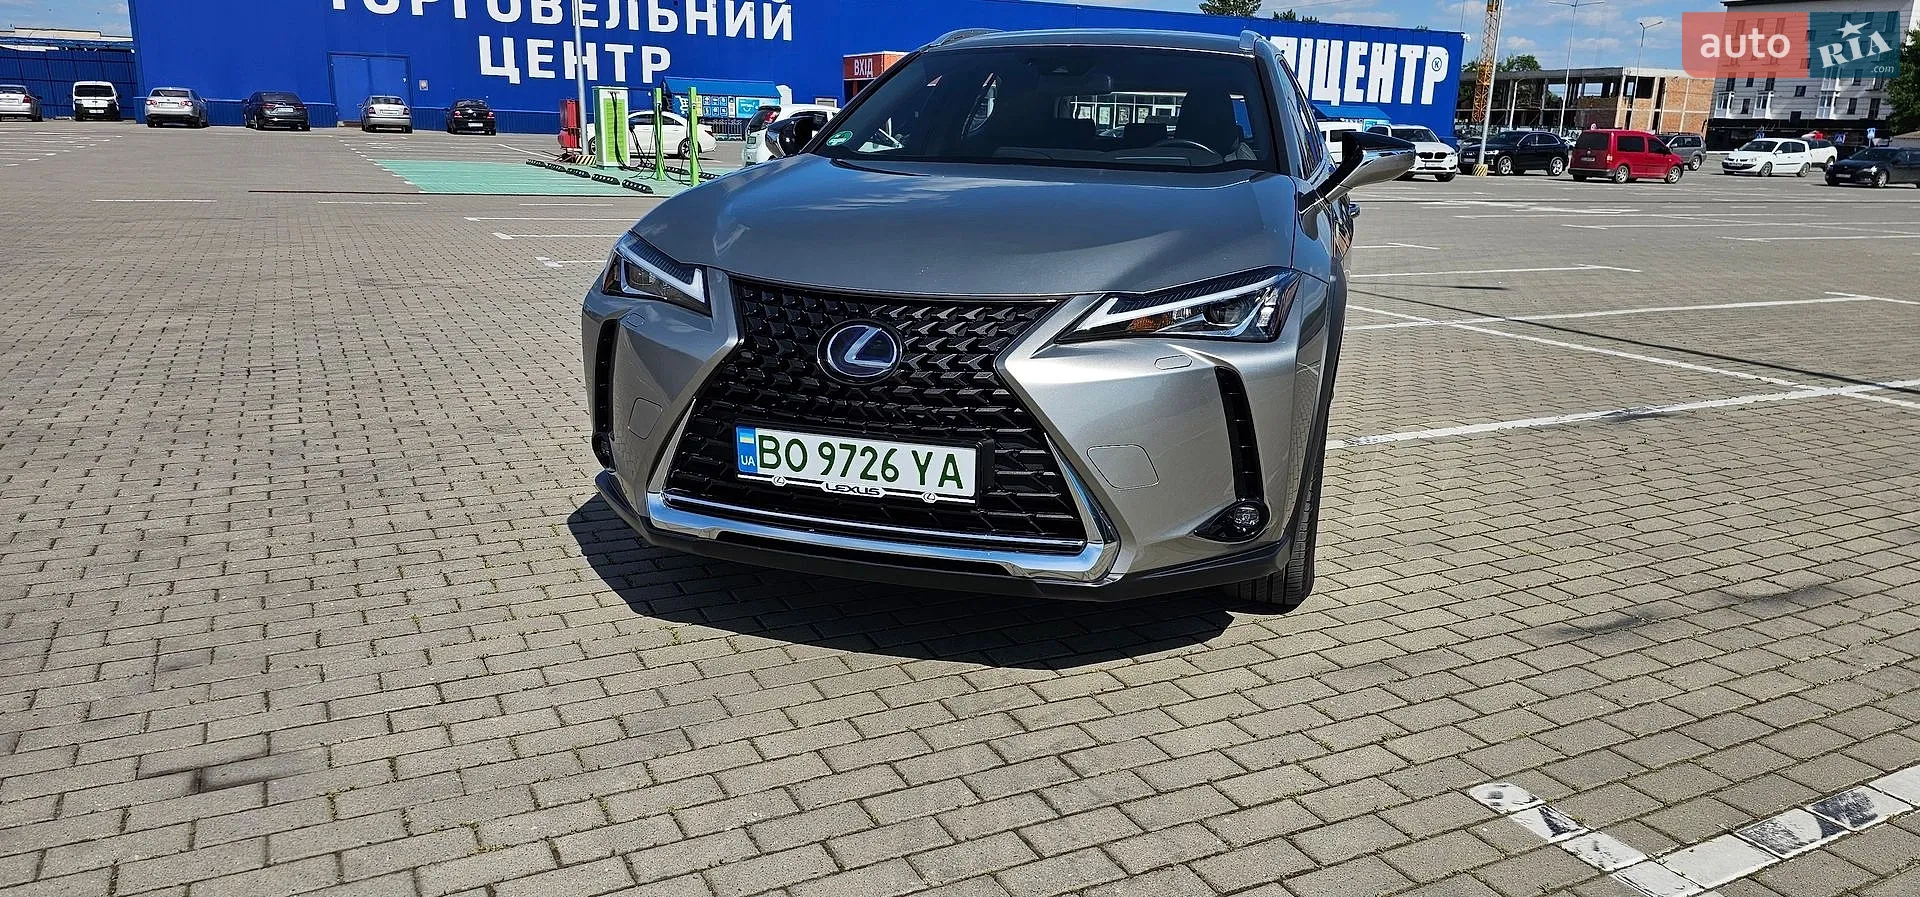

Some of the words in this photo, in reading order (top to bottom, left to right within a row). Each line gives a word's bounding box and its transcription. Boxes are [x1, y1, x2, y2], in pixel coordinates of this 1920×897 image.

[331, 0, 792, 41] ОВЕЛЬНИЙ
[478, 35, 671, 84] ЦЕНТР
[854, 58, 873, 77] ВХІД
[1270, 36, 1449, 106] ІЦЕНТР
[741, 455, 756, 466] UA
[758, 434, 808, 473] BO
[818, 441, 900, 483] 9726
[912, 450, 964, 490] YA
[825, 482, 880, 496] LEXUS
